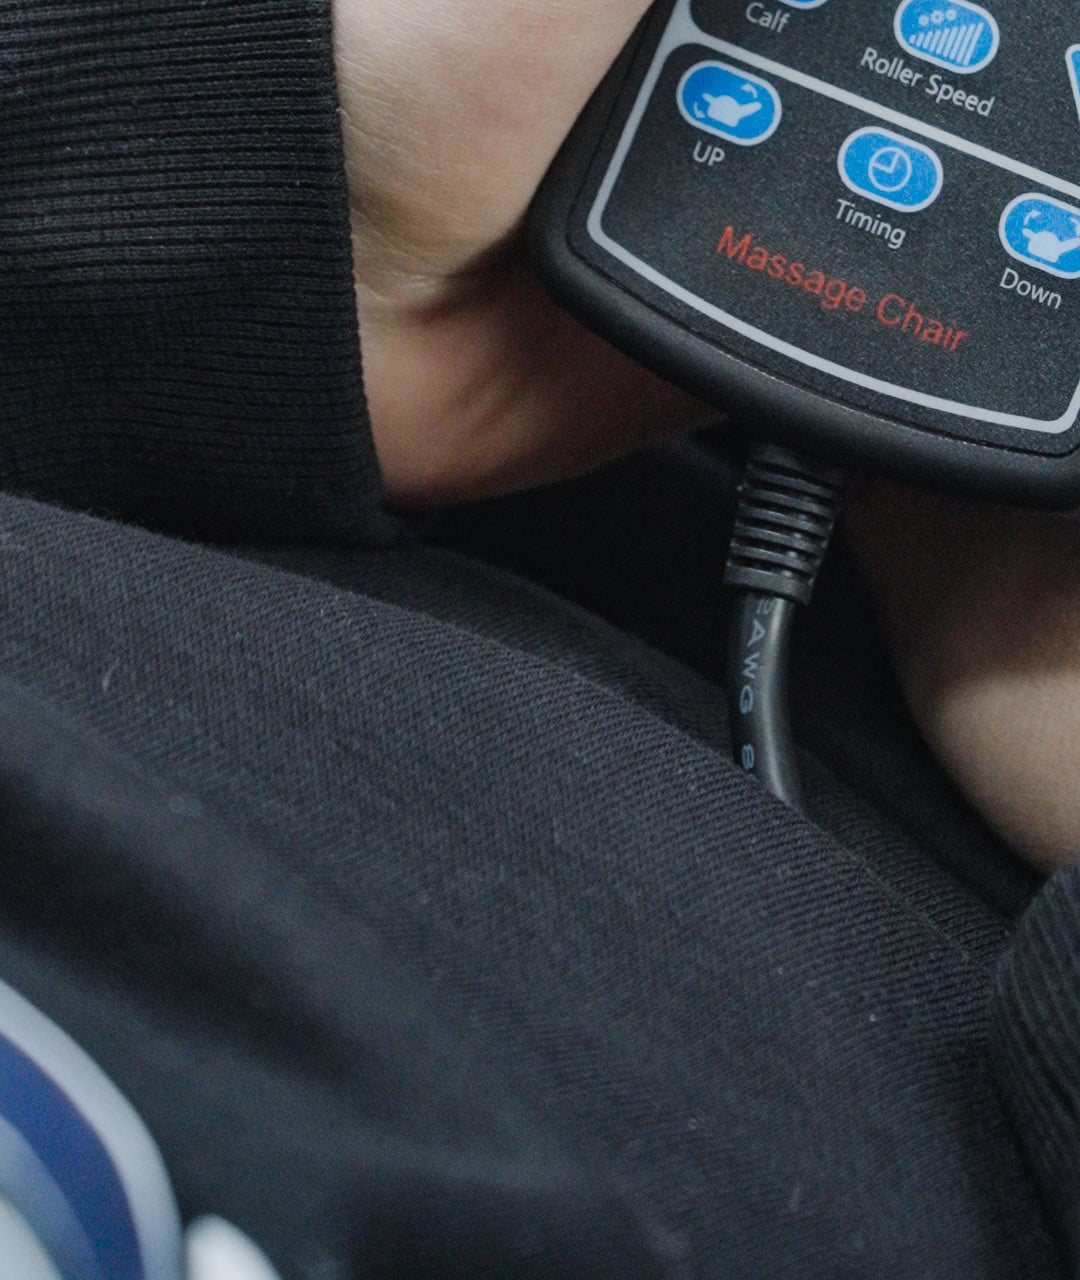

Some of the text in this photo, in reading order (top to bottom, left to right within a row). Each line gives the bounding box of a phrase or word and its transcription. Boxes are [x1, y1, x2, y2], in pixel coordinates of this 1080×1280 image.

[745, 1, 790, 35] Calf
[860, 47, 996, 118] Roller Speed
[834, 200, 907, 250] Timing
[717, 226, 969, 353] Massage Chair
[1000, 268, 1063, 311] Down
